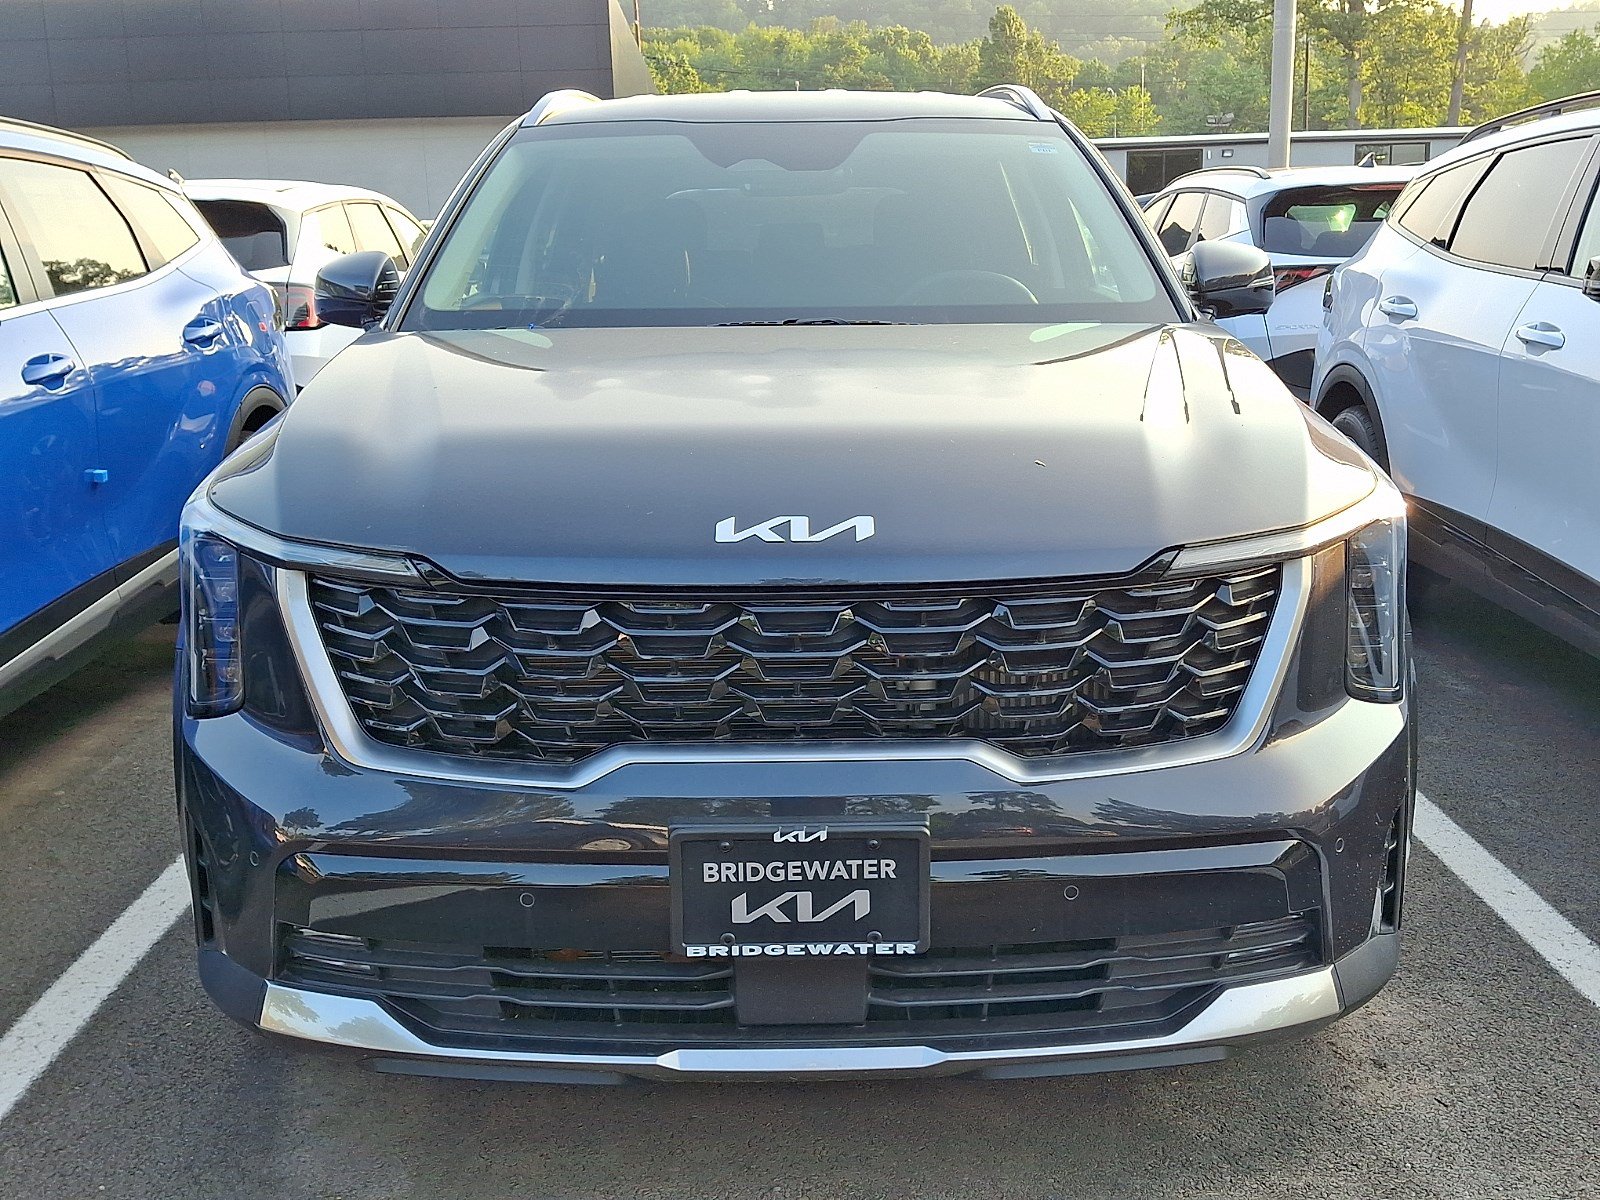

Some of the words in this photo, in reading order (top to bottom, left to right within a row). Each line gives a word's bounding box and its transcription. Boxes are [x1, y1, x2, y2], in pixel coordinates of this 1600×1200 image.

[715, 515, 875, 542] KIA
[773, 826, 828, 843] KIA
[703, 859, 897, 882] BRIDGEWATER
[731, 889, 870, 923] KIA
[686, 943, 916, 957] BRIDGEWATER
